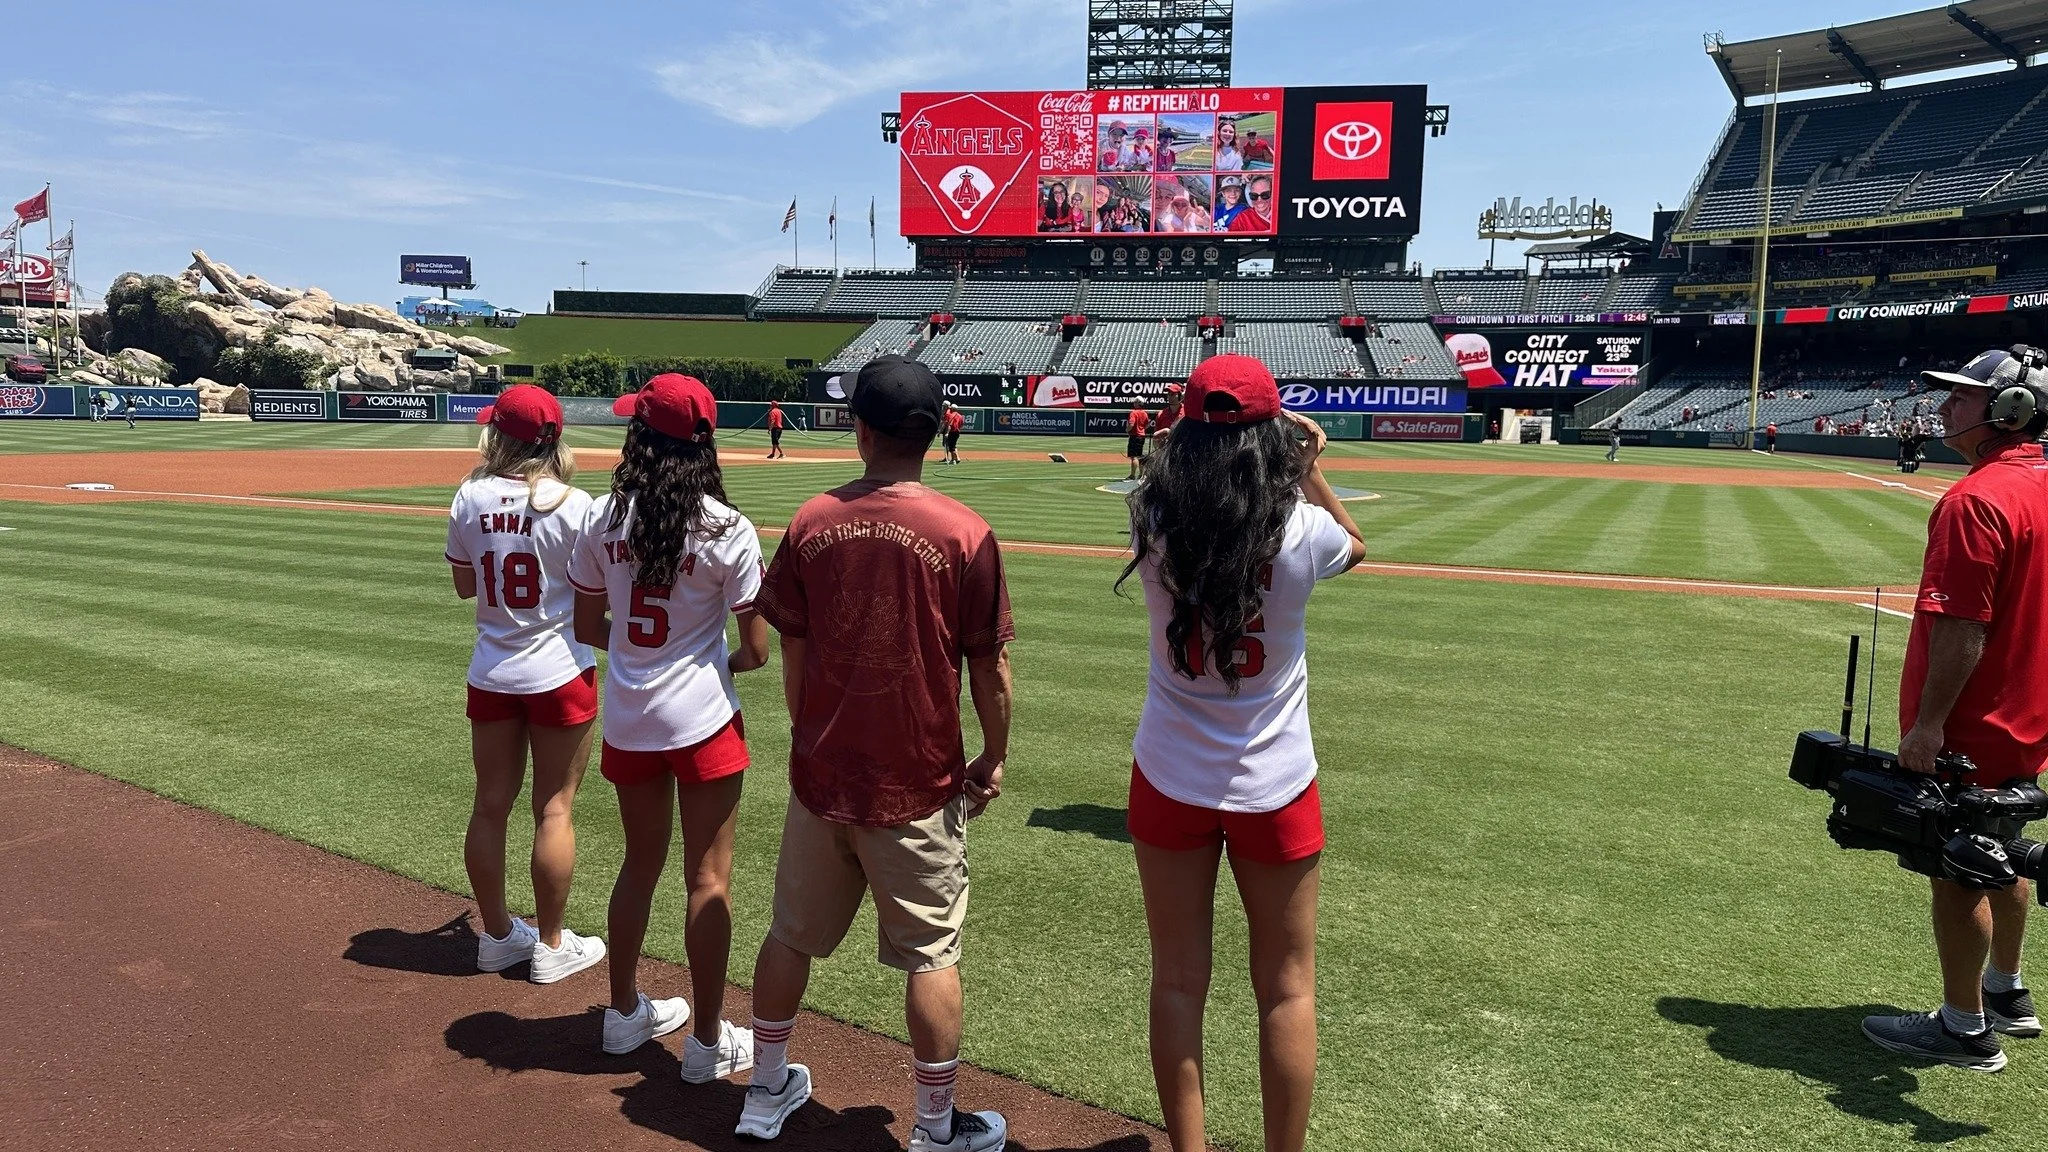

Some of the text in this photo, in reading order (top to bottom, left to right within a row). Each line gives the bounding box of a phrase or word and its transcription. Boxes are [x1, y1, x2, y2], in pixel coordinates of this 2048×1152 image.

[1038, 92, 1096, 113] Coca-Cola
[910, 115, 1023, 155] ANGELS
[1292, 196, 1407, 219] TOYOTA
[1496, 196, 1593, 228] Modelo
[1875, 217, 1899, 225] BREWERY
[1930, 211, 1953, 219] STADIUM
[1771, 225, 1808, 235] RESTAURANT
[1848, 220, 1864, 228] FANS
[1838, 301, 1957, 320] CITY CONNECT HAT
[1456, 316, 1503, 324] COUNTDOWN
[1505, 315, 1514, 323] TO
[1516, 315, 1539, 324] FIRST
[1541, 314, 1564, 323] PITCH
[1575, 314, 1595, 322] 22:05
[1623, 313, 1647, 322] 12:45
[1527, 335, 1568, 348] CITY
[1596, 337, 1641, 345] SATURDAY
[1604, 345, 1632, 353] AUG.
[1505, 350, 1589, 363] CONNECT
[1606, 353, 1630, 361] 23RD
[1513, 364, 1578, 387] HAT
[1017, 379, 1023, 388] 3
[1086, 381, 1120, 394] CITY
[366, 396, 427, 407] YOKOHAMA
[1017, 395, 1023, 404] 0
[1326, 386, 1447, 406] HYUNDAI
[254, 402, 317, 413] REDIENTS
[400, 410, 427, 419] TIRES
[1012, 418, 1071, 426] OCNAVIGATOR.ORG
[1088, 418, 1118, 427] NITTO
[480, 513, 533, 538] EMMA
[481, 551, 542, 609] 18
[627, 582, 671, 648] 5
[1839, 804, 1847, 816] 4
